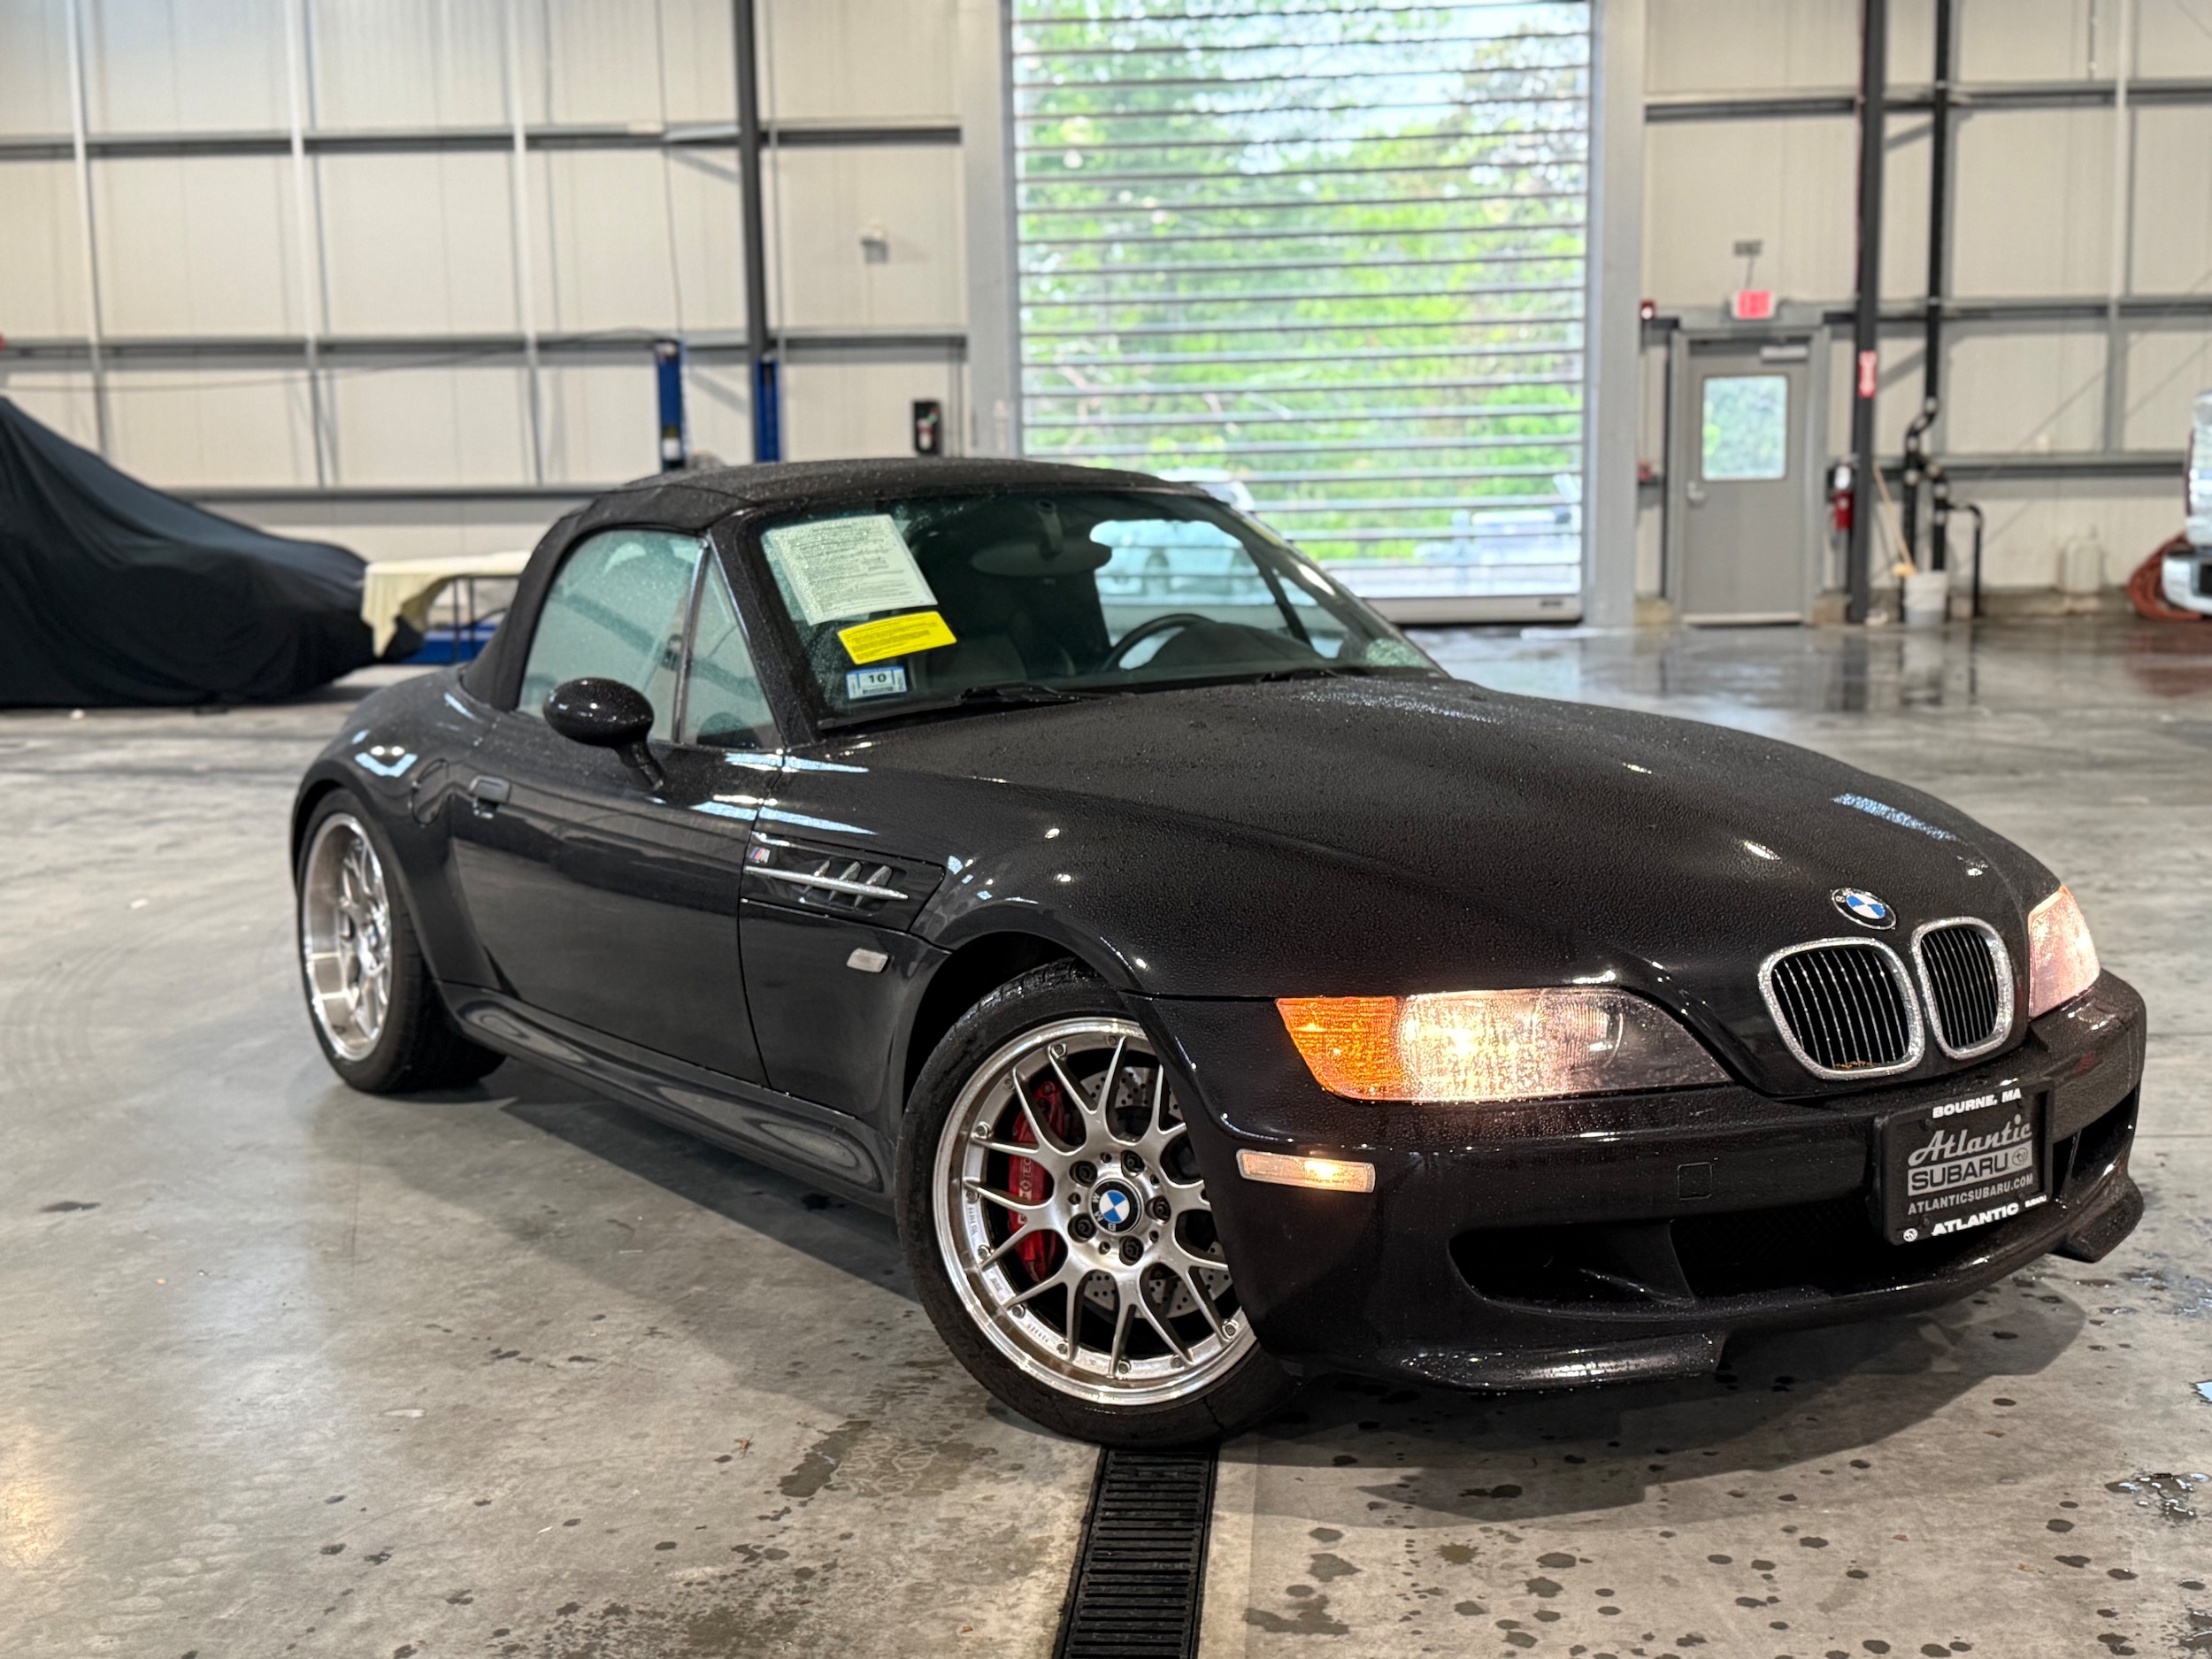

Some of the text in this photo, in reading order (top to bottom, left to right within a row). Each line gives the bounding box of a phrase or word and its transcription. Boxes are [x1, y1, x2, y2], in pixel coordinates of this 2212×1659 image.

[868, 673, 887, 684] 10
[1932, 1087, 2022, 1118] BOURNE, MA
[1908, 1114, 2032, 1166] Atlantic
[1911, 1152, 2008, 1191] SUBARU
[1091, 1192, 1118, 1233] BMW
[1908, 1172, 2033, 1216] ATLANTICSUBARU.COM
[1931, 1202, 2019, 1237] ATLANTIC
